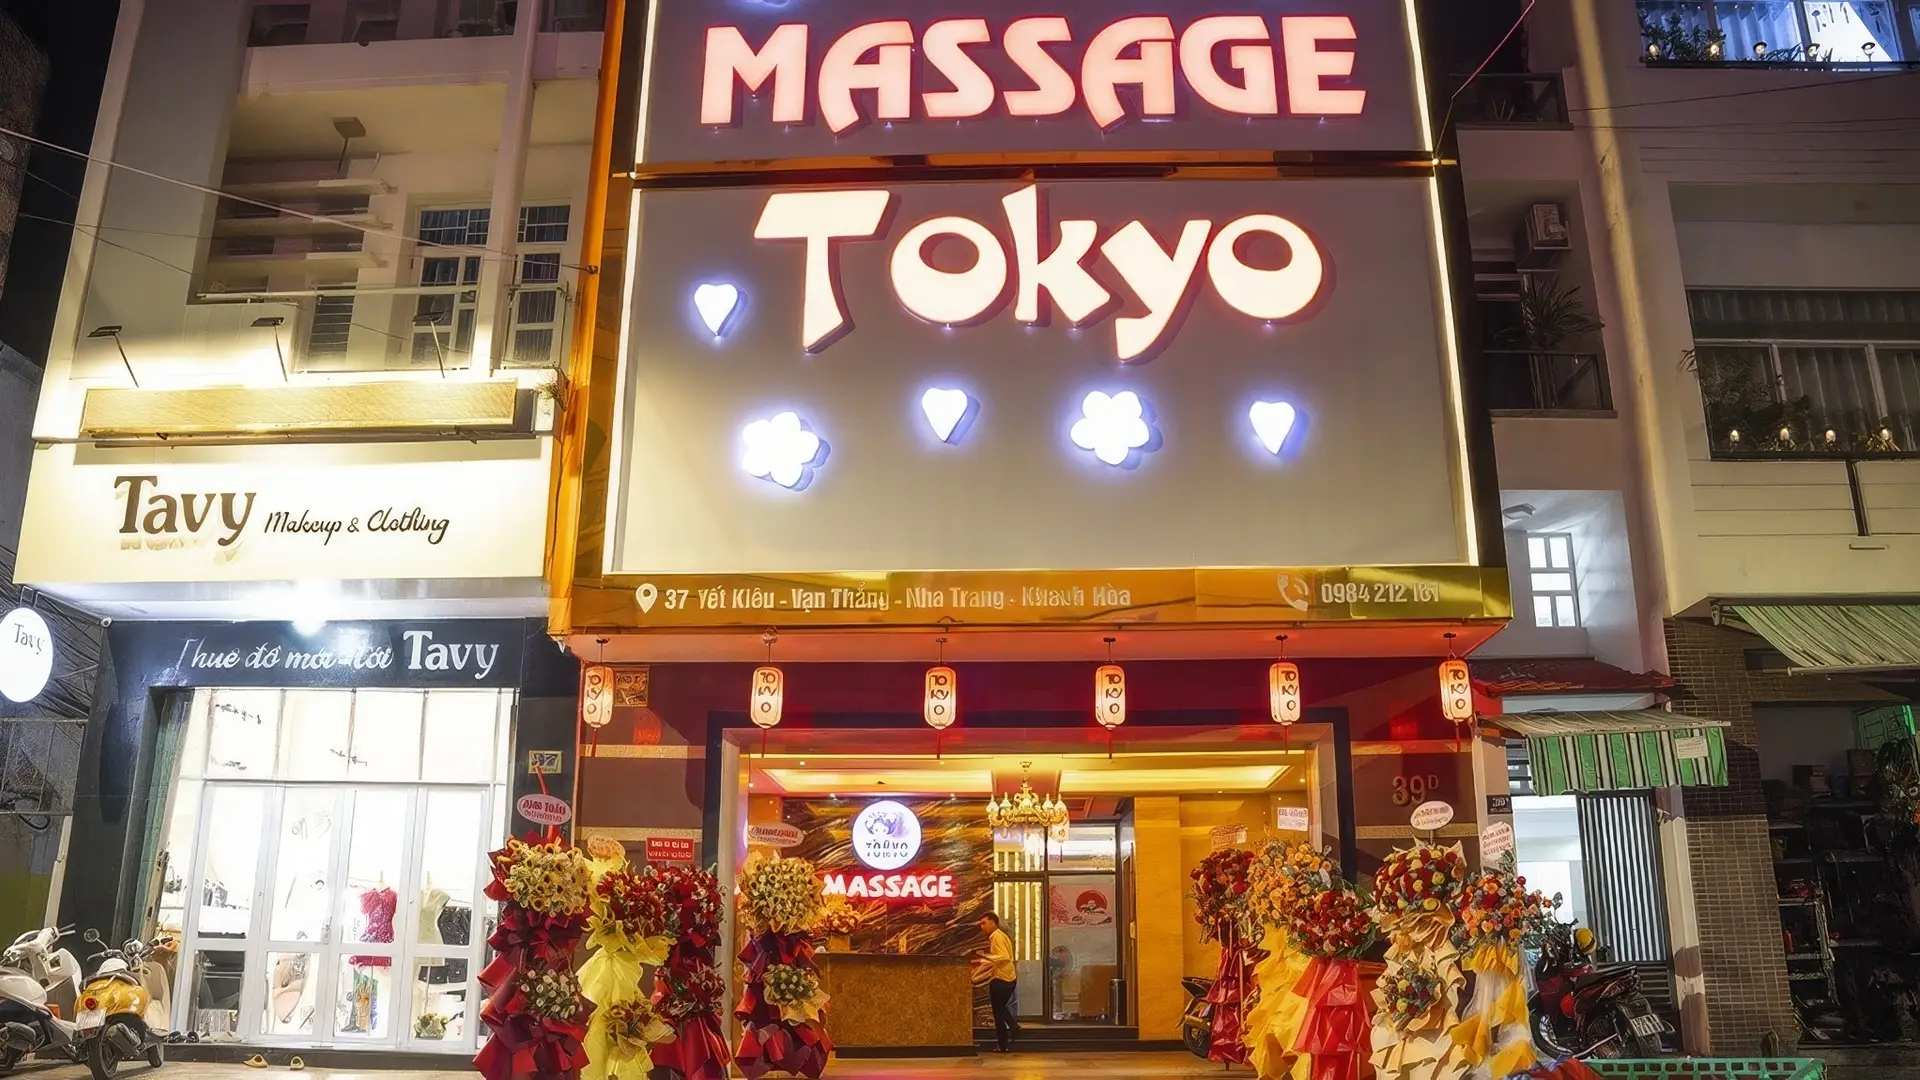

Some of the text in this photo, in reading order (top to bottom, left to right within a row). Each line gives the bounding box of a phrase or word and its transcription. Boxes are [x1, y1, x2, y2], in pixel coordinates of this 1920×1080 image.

[700, 16, 1367, 136] MASSAGE
[114, 475, 450, 546] Tavy Makeup & Clothing
[664, 588, 689, 609] 37
[906, 586, 943, 608] Nha
[949, 587, 1004, 610] Trang
[1321, 583, 1370, 603] 0984
[1374, 582, 1407, 603] 212
[403, 630, 499, 680] Tavy
[821, 874, 953, 899] MASSAGE
